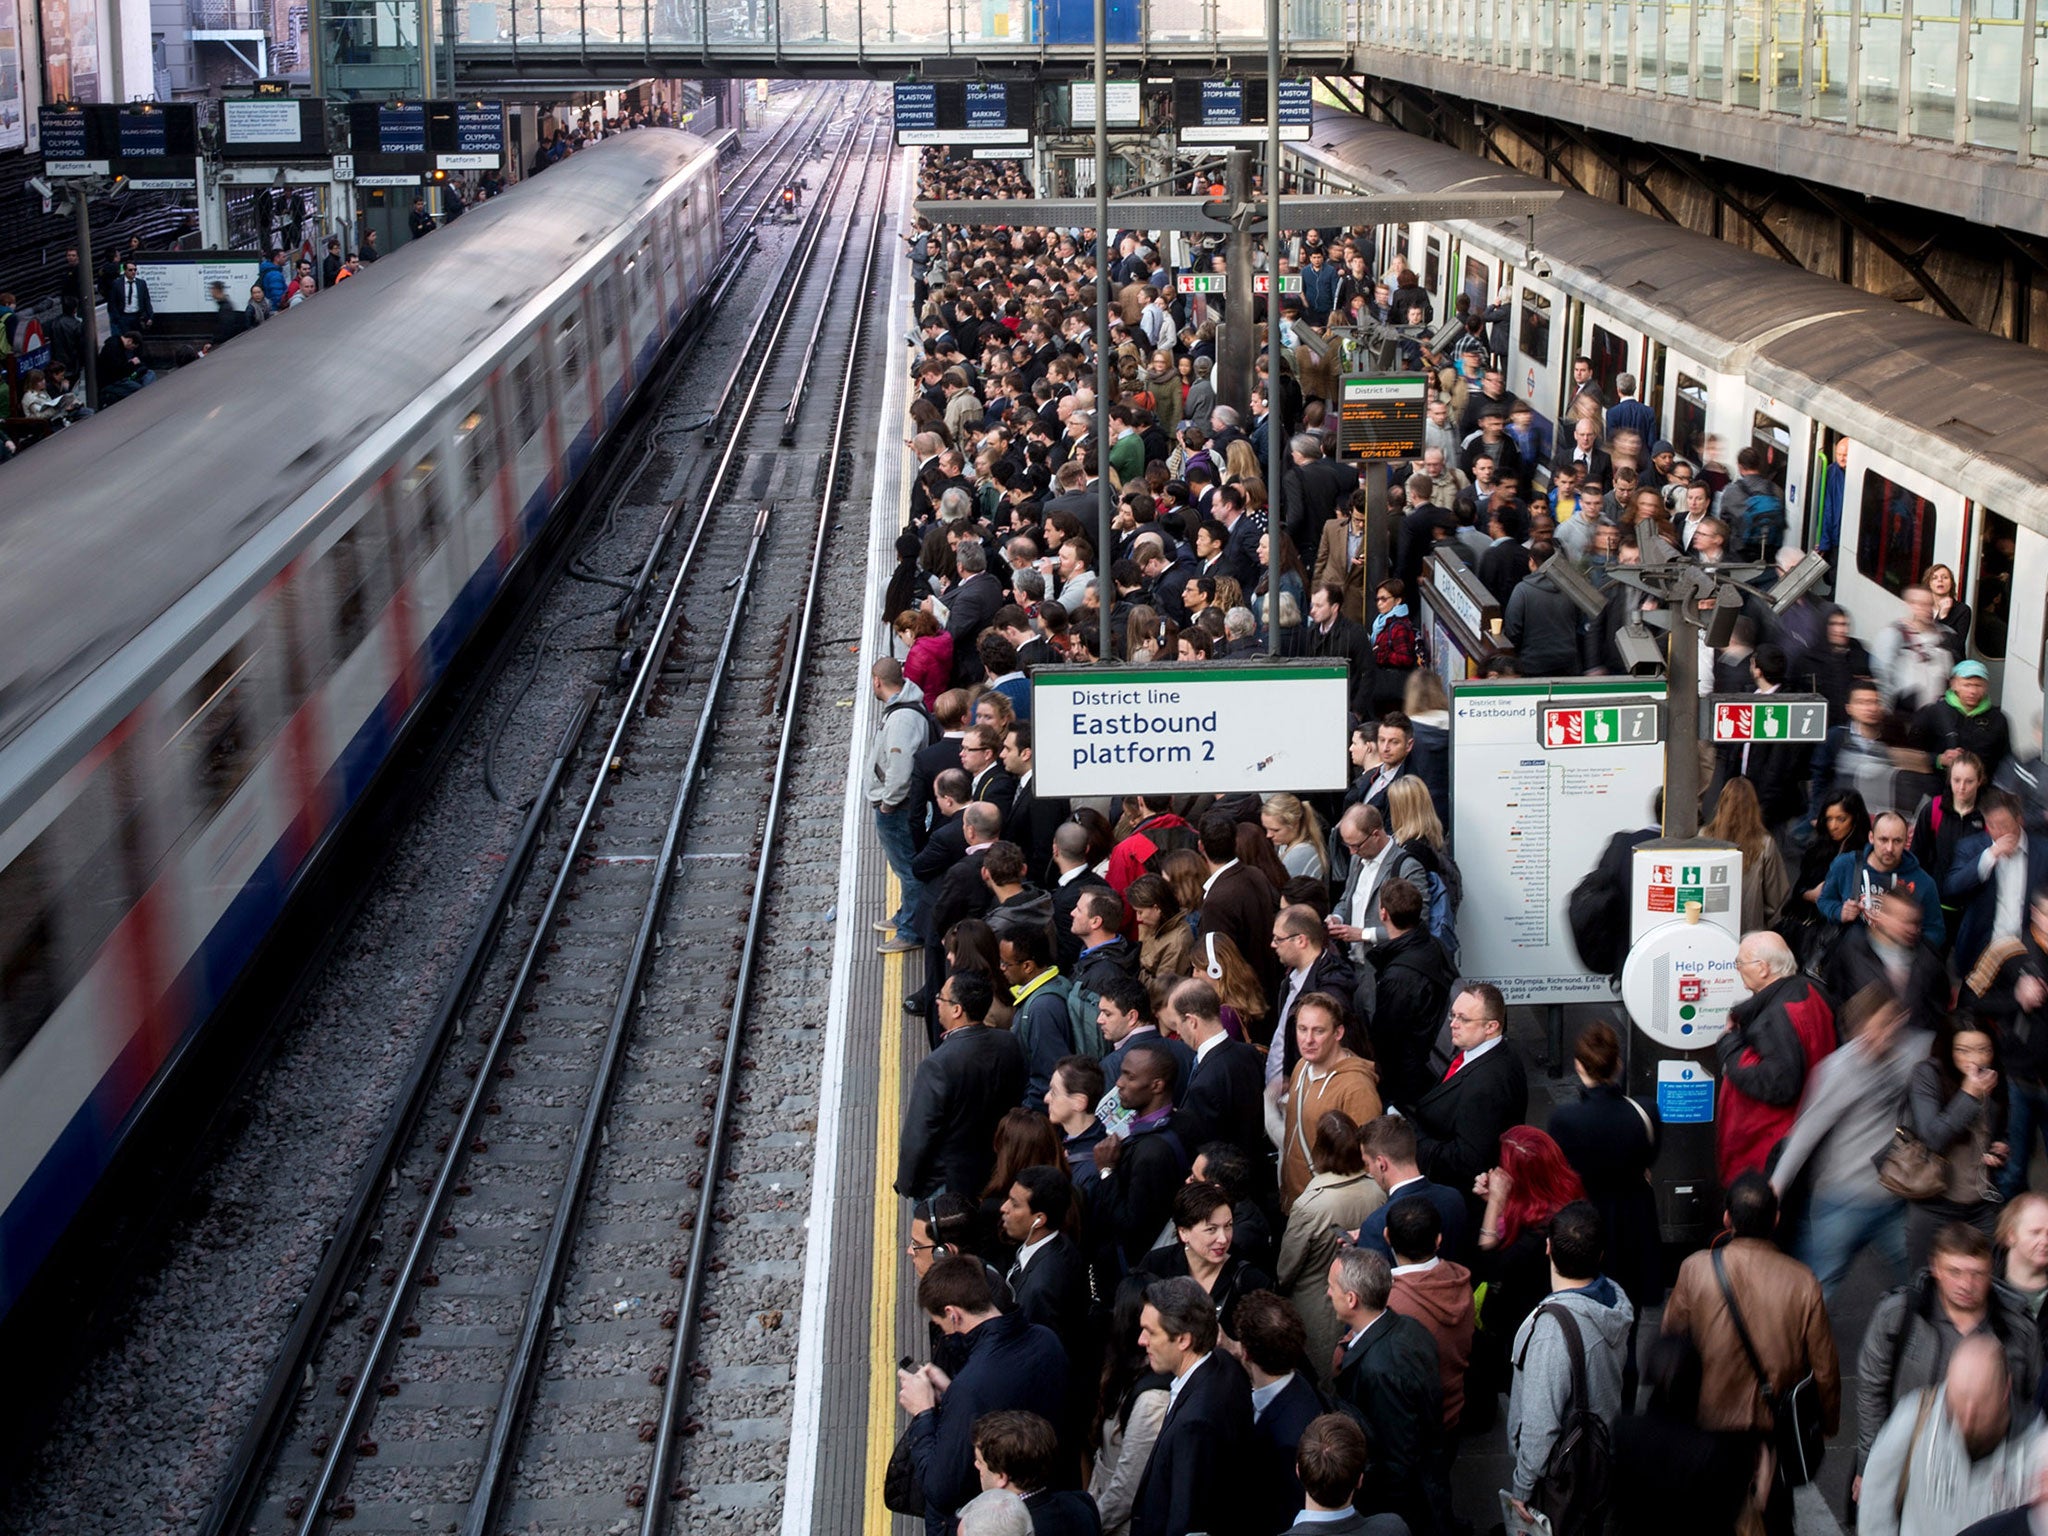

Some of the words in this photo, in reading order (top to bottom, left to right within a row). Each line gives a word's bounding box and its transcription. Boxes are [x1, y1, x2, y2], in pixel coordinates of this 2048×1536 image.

[382, 144, 406, 152] STOPS
[54, 162, 85, 170] Platform
[338, 157, 349, 168] H
[141, 181, 173, 189] Piccadilly
[361, 177, 394, 185] Piccadilly
[1354, 387, 1383, 395] District
[1361, 450, 1401, 458] 07:41:02
[1072, 690, 1141, 705] District
[1148, 689, 1180, 704] line
[1469, 699, 1497, 707] District
[1469, 708, 1526, 718] Eastbound
[1073, 711, 1217, 735] Eastbound
[1073, 741, 1191, 770] platform
[1202, 740, 1216, 761] 2
[1675, 961, 1704, 972] Help
[1708, 960, 1737, 971] Point
[1586, 976, 1606, 984] Ealing
[1714, 977, 1735, 985] Alarm
[1564, 985, 1591, 993] subway
